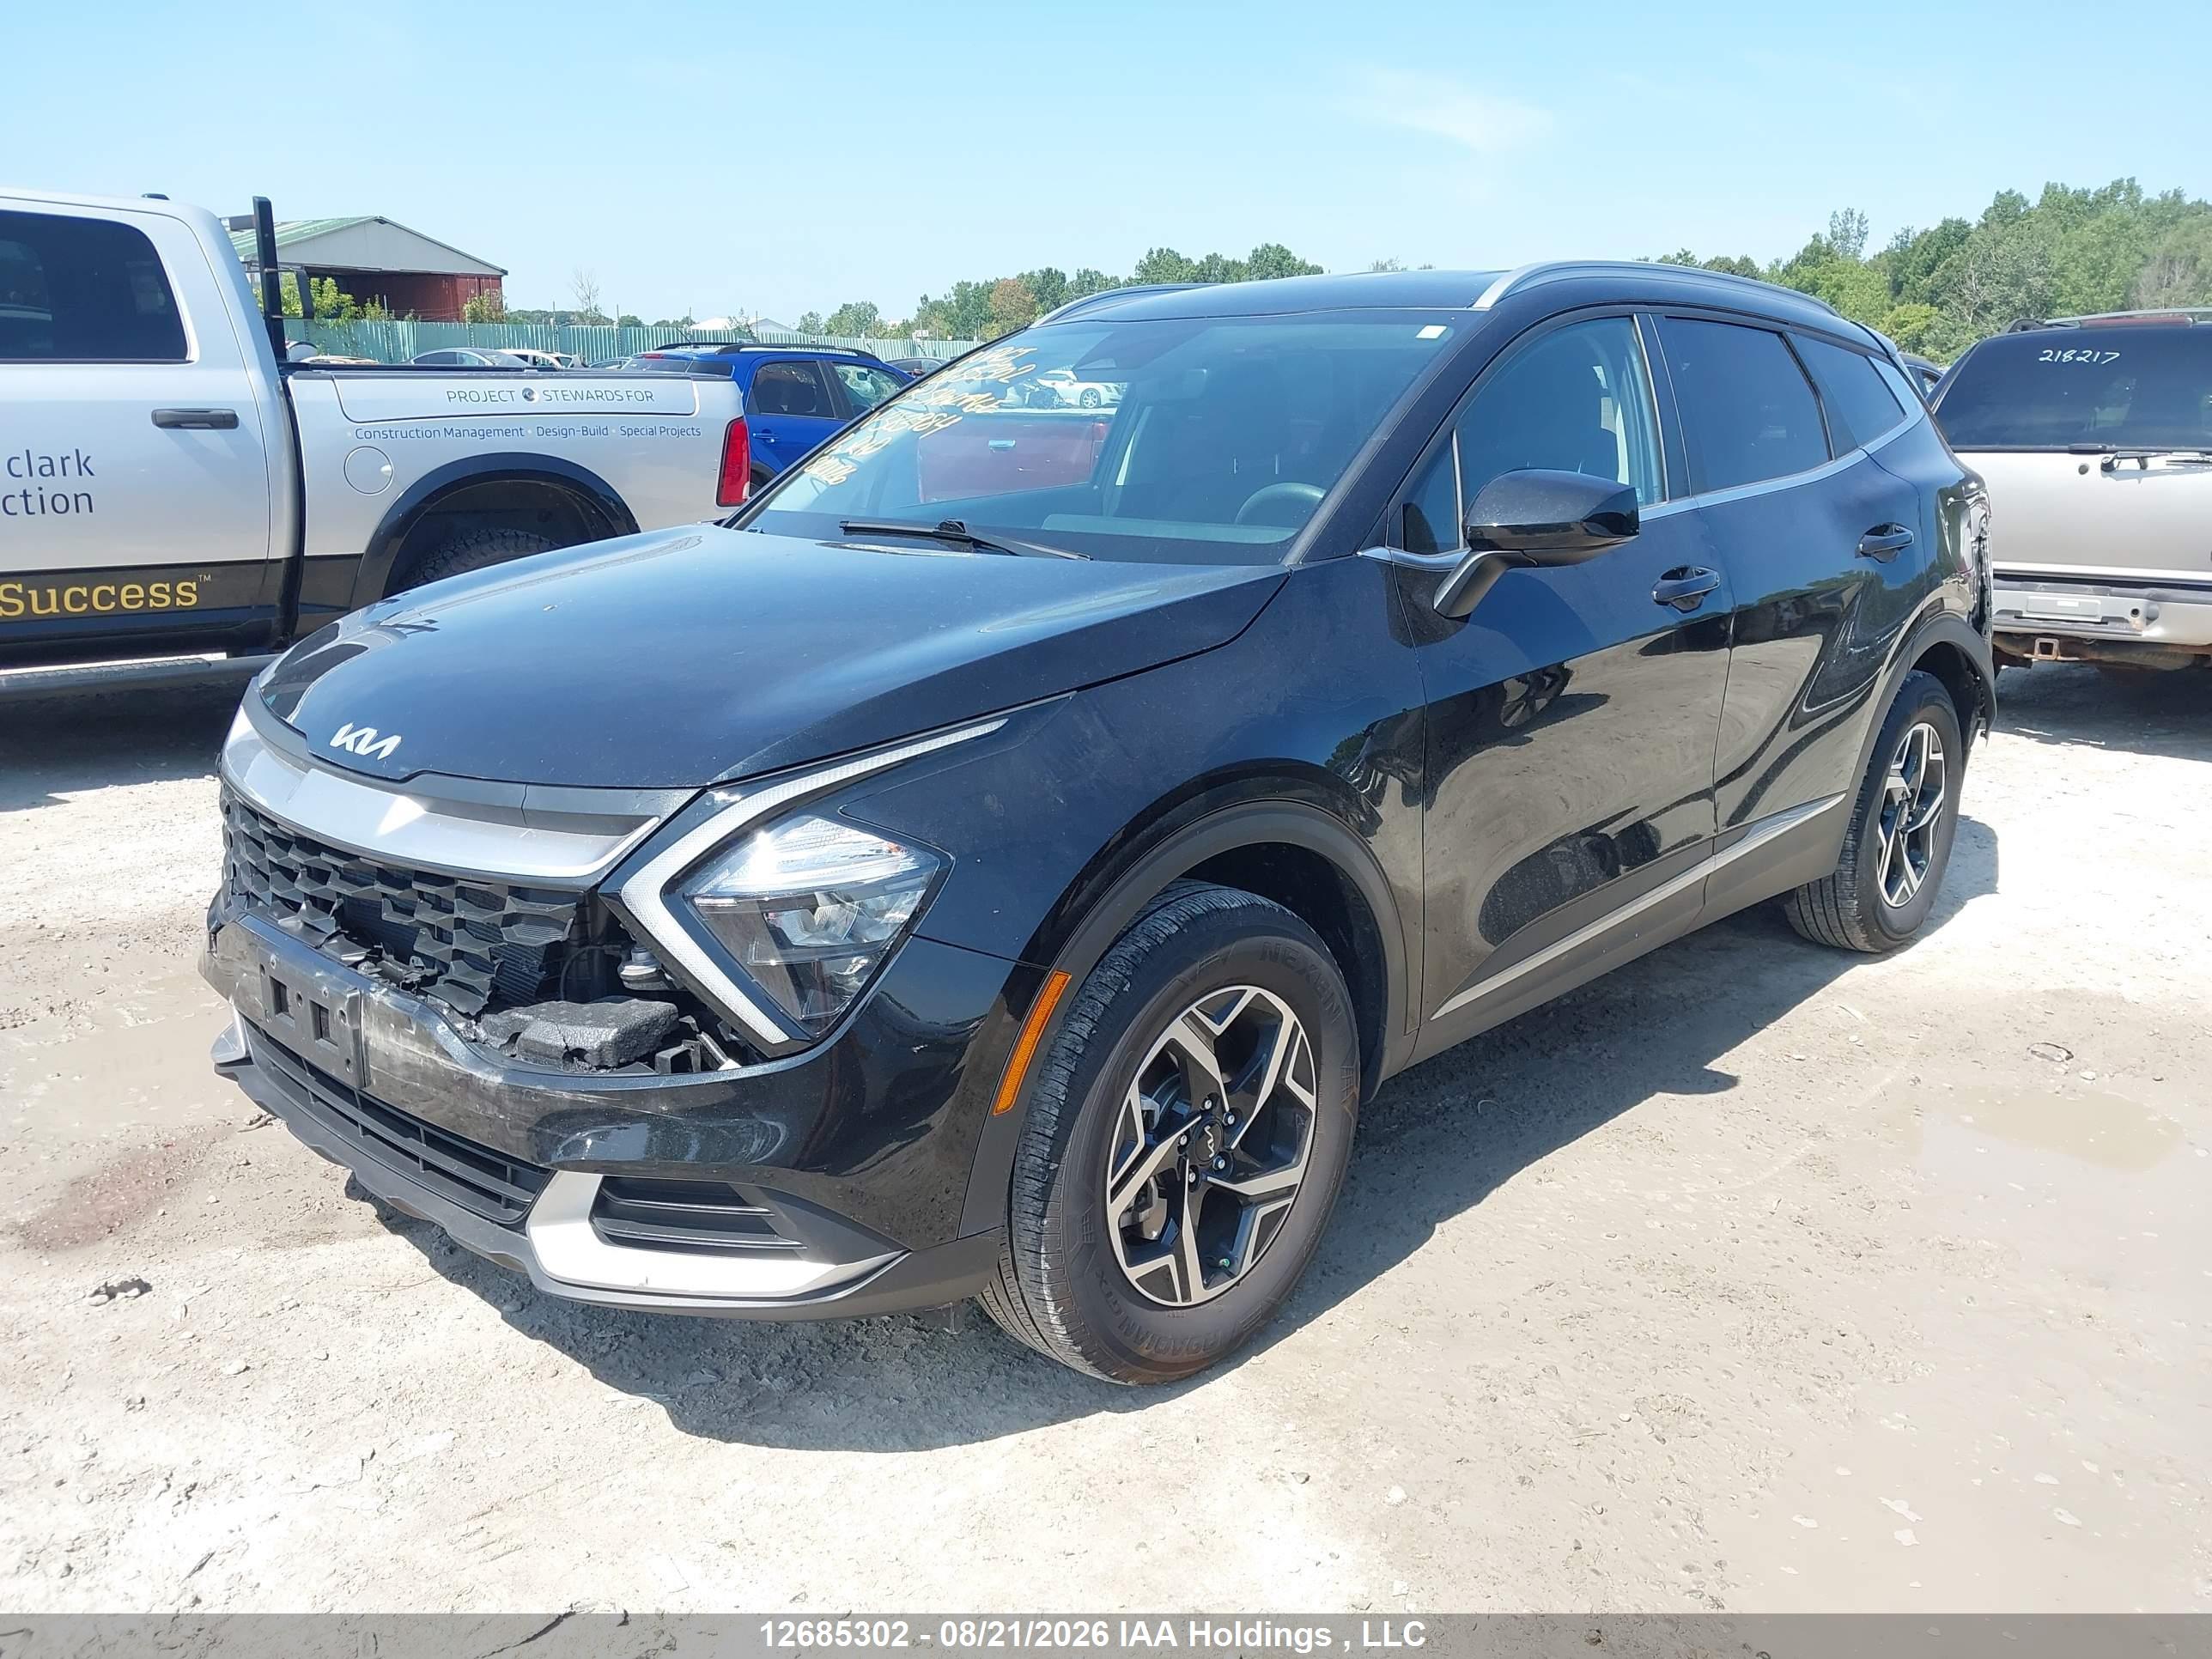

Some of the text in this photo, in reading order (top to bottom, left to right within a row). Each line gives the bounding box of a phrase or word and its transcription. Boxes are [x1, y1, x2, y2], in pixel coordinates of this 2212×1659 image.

[2038, 349, 2121, 366] 218217
[446, 389, 656, 404] PROJECT STEWARDS FOR
[355, 425, 702, 441] Construction Management Design-Build Special Projects
[6, 448, 95, 478] clark
[0, 581, 198, 617] Success
